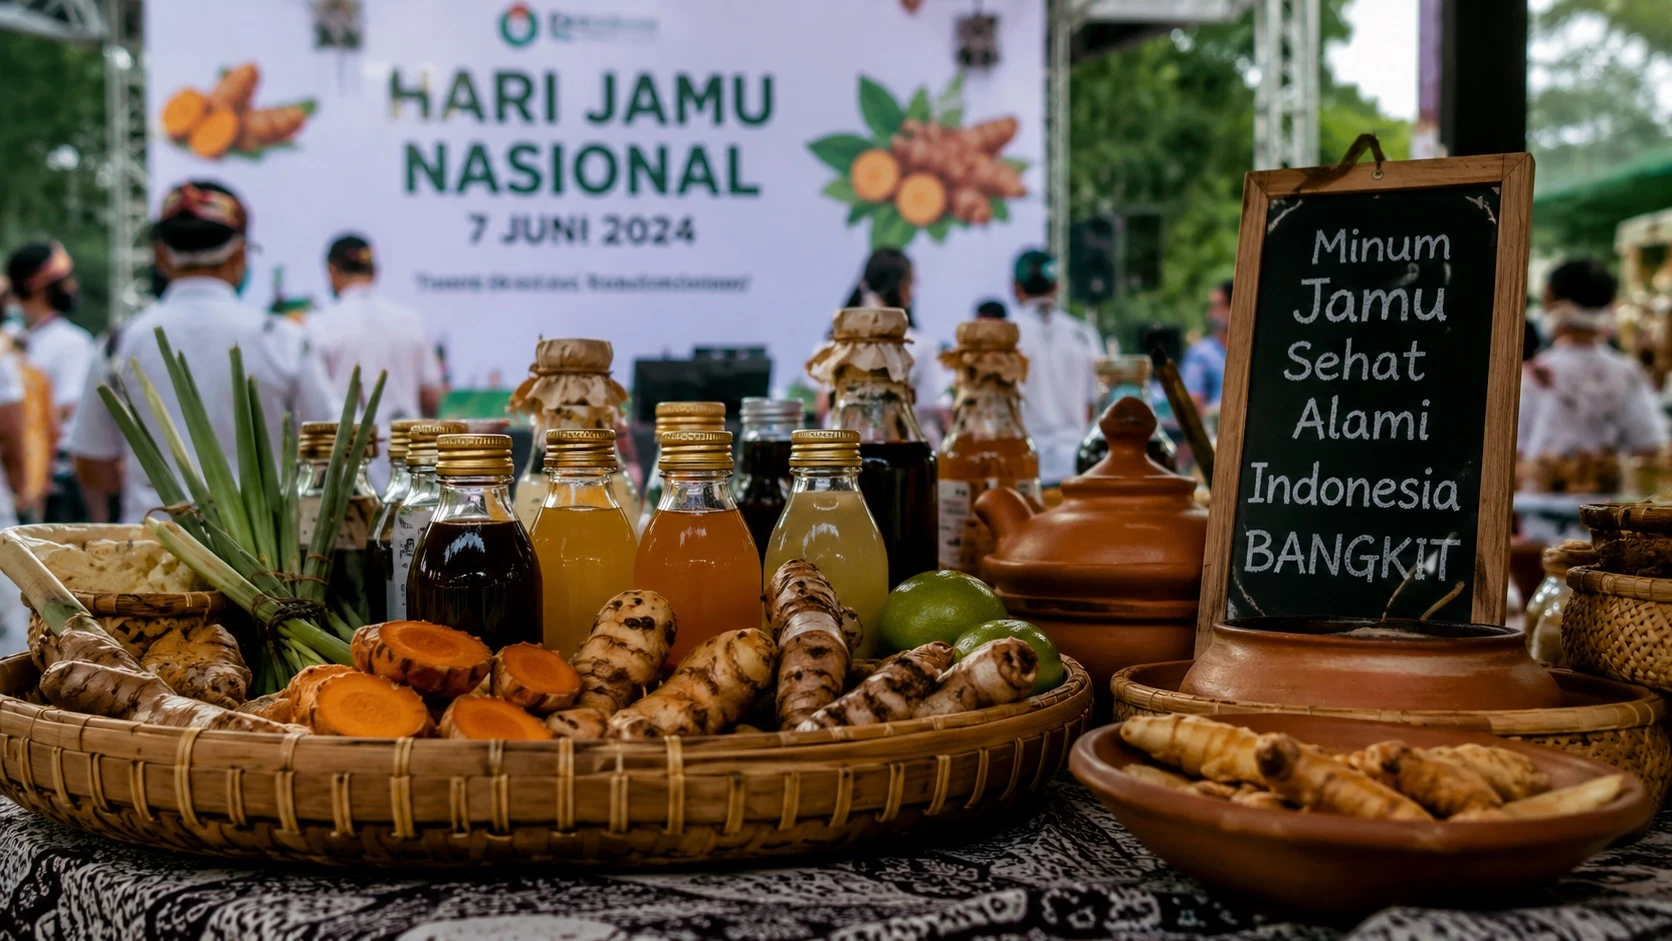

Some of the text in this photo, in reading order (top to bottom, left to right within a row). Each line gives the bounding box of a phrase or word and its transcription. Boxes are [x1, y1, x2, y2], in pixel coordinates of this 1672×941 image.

[388, 68, 775, 128] HARI JAMU
[405, 140, 762, 198] NASIONAL
[467, 214, 697, 247] 7 JUNI 2024
[1312, 228, 1451, 265] Minum
[1292, 276, 1447, 325] Jamu
[1283, 337, 1427, 382] Sehat
[1291, 395, 1431, 441] Alami
[1247, 461, 1461, 512] Indonesia
[1244, 529, 1462, 582] BANGKIT
